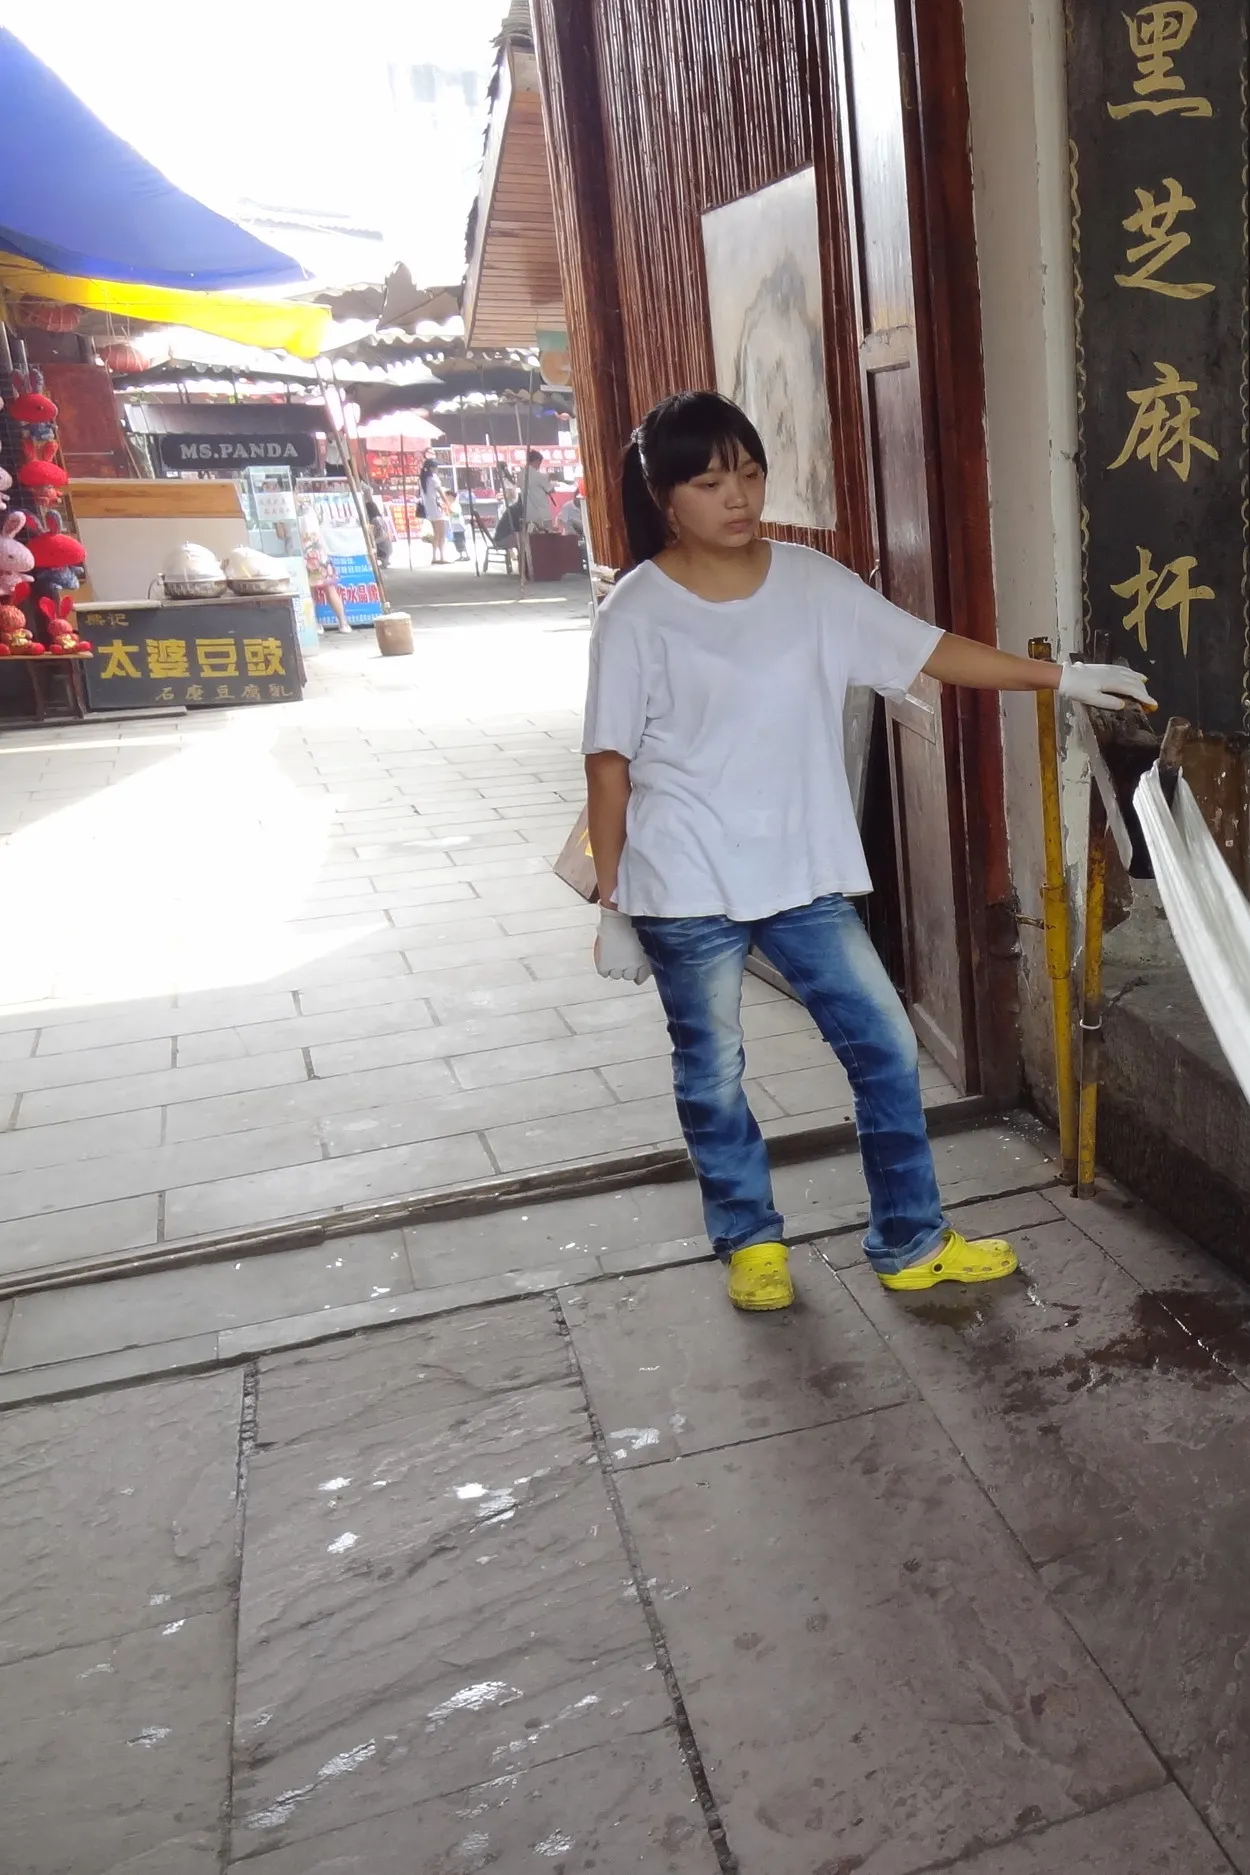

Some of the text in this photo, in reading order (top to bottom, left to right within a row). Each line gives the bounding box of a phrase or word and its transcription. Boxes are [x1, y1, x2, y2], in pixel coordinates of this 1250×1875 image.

[1106, 1, 1220, 659] 黑芝麻杆
[180, 443, 299, 459] MS.PANDA
[97, 637, 286, 680] 太婆豆豉
